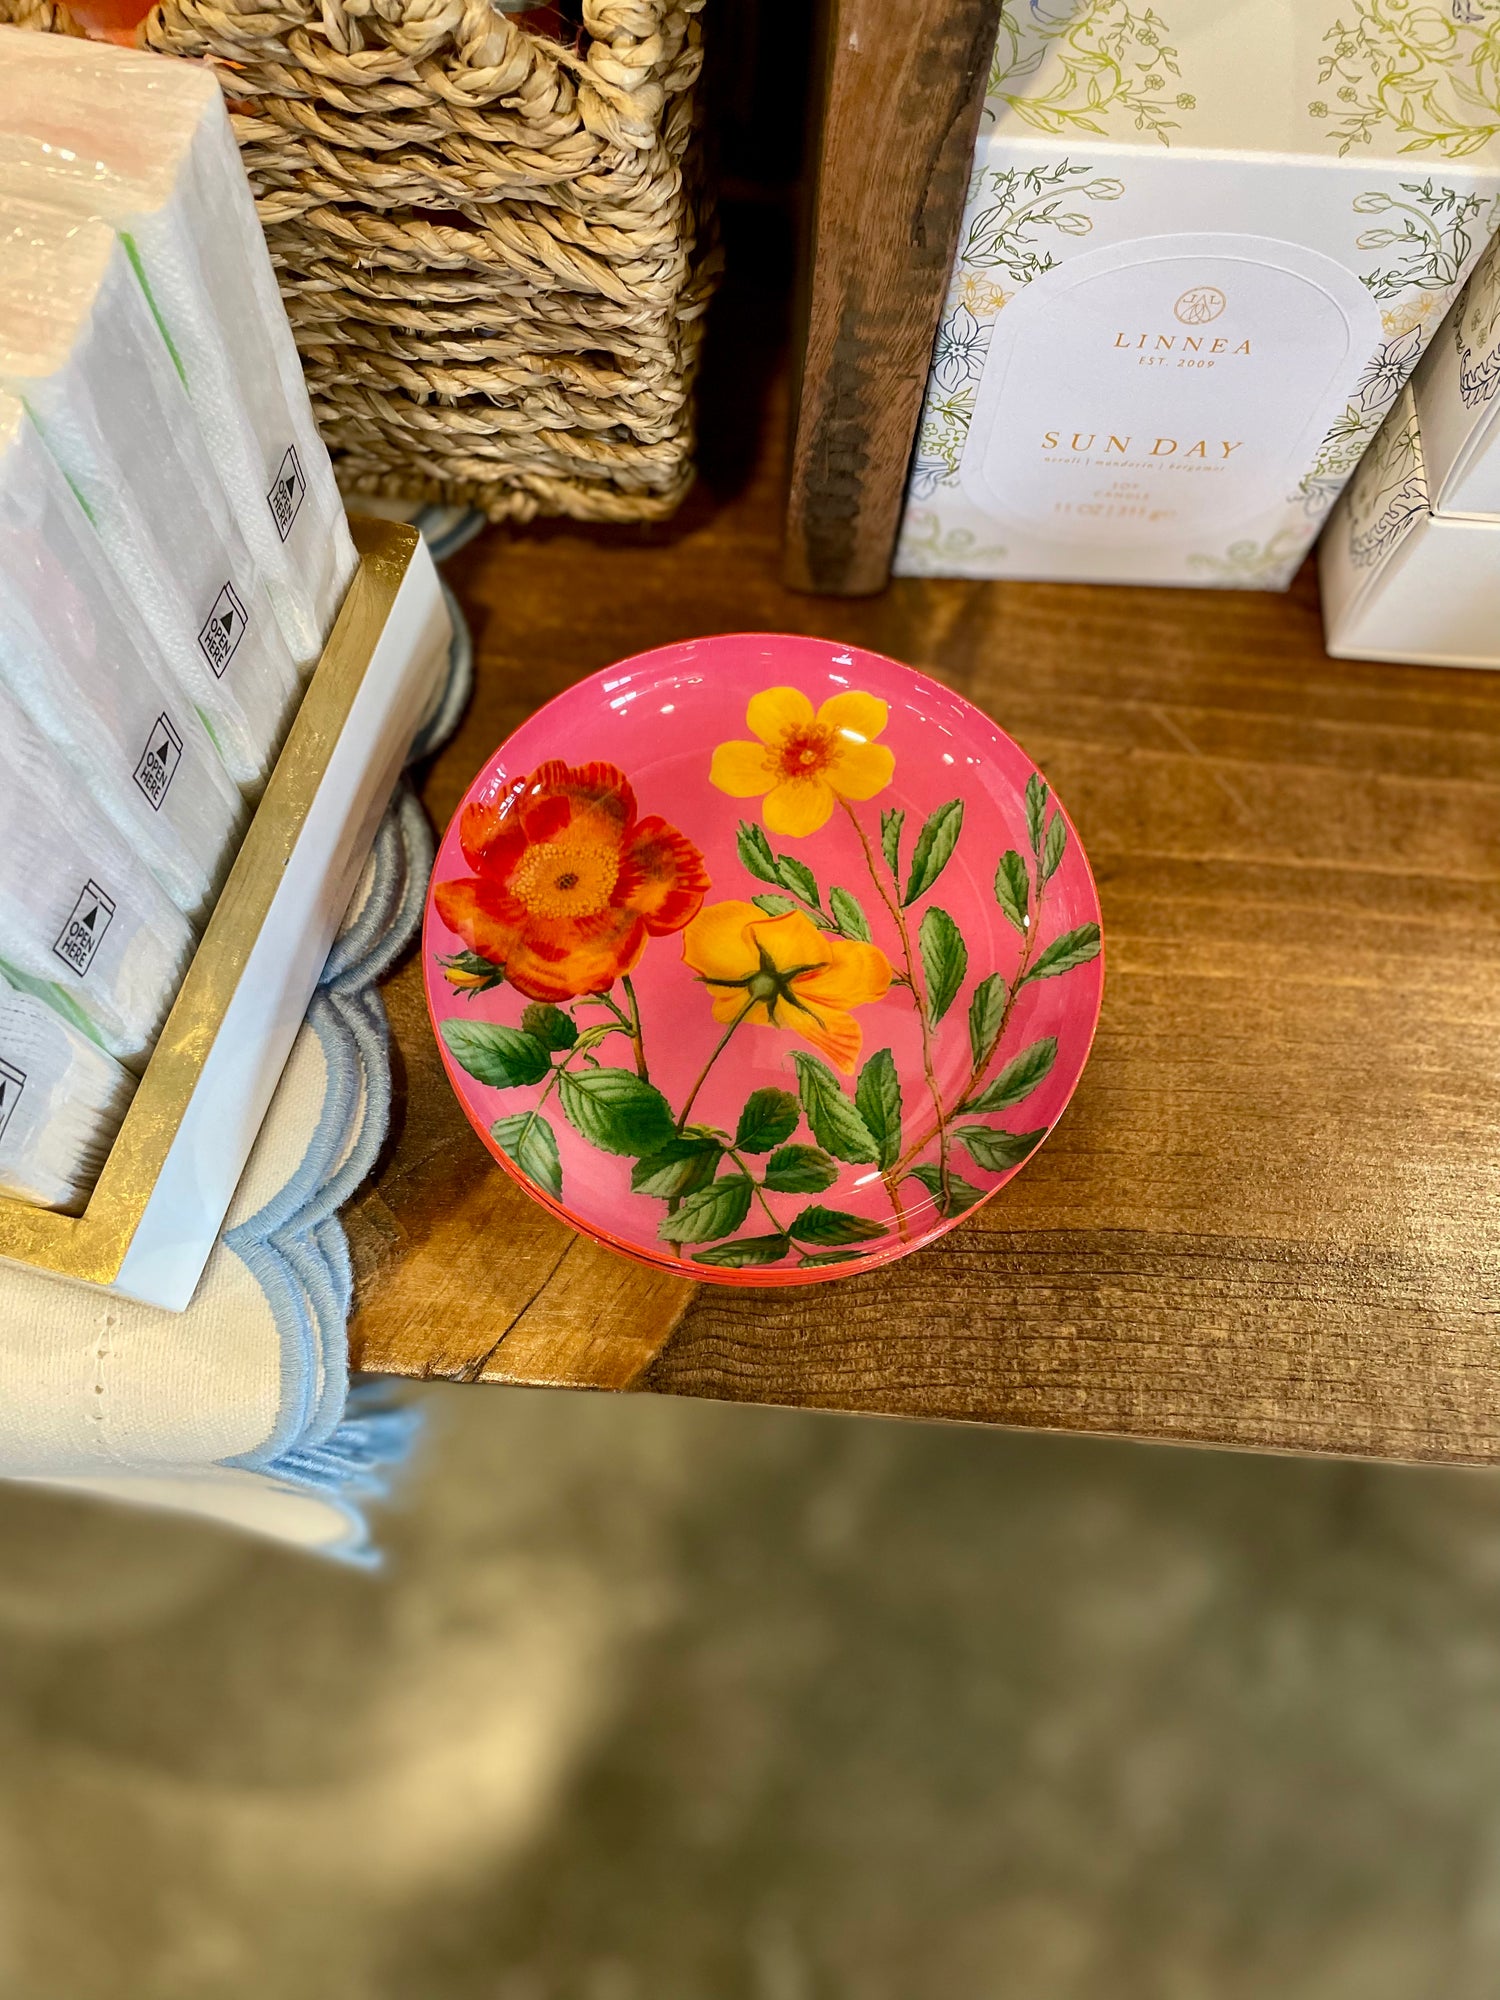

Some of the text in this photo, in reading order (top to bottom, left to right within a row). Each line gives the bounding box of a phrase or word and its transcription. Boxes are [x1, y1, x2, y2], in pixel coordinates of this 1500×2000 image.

[1113, 332, 1252, 354] LINNEA
[1138, 356, 1215, 368] EST. 2009
[1041, 431, 1243, 459] SUN DAY
[204, 631, 224, 668] HERE
[210, 617, 232, 657] OPEN
[140, 766, 161, 801] HERE
[146, 751, 168, 788] OPEN
[61, 936, 87, 967] HERE
[69, 921, 95, 953] OPEN
